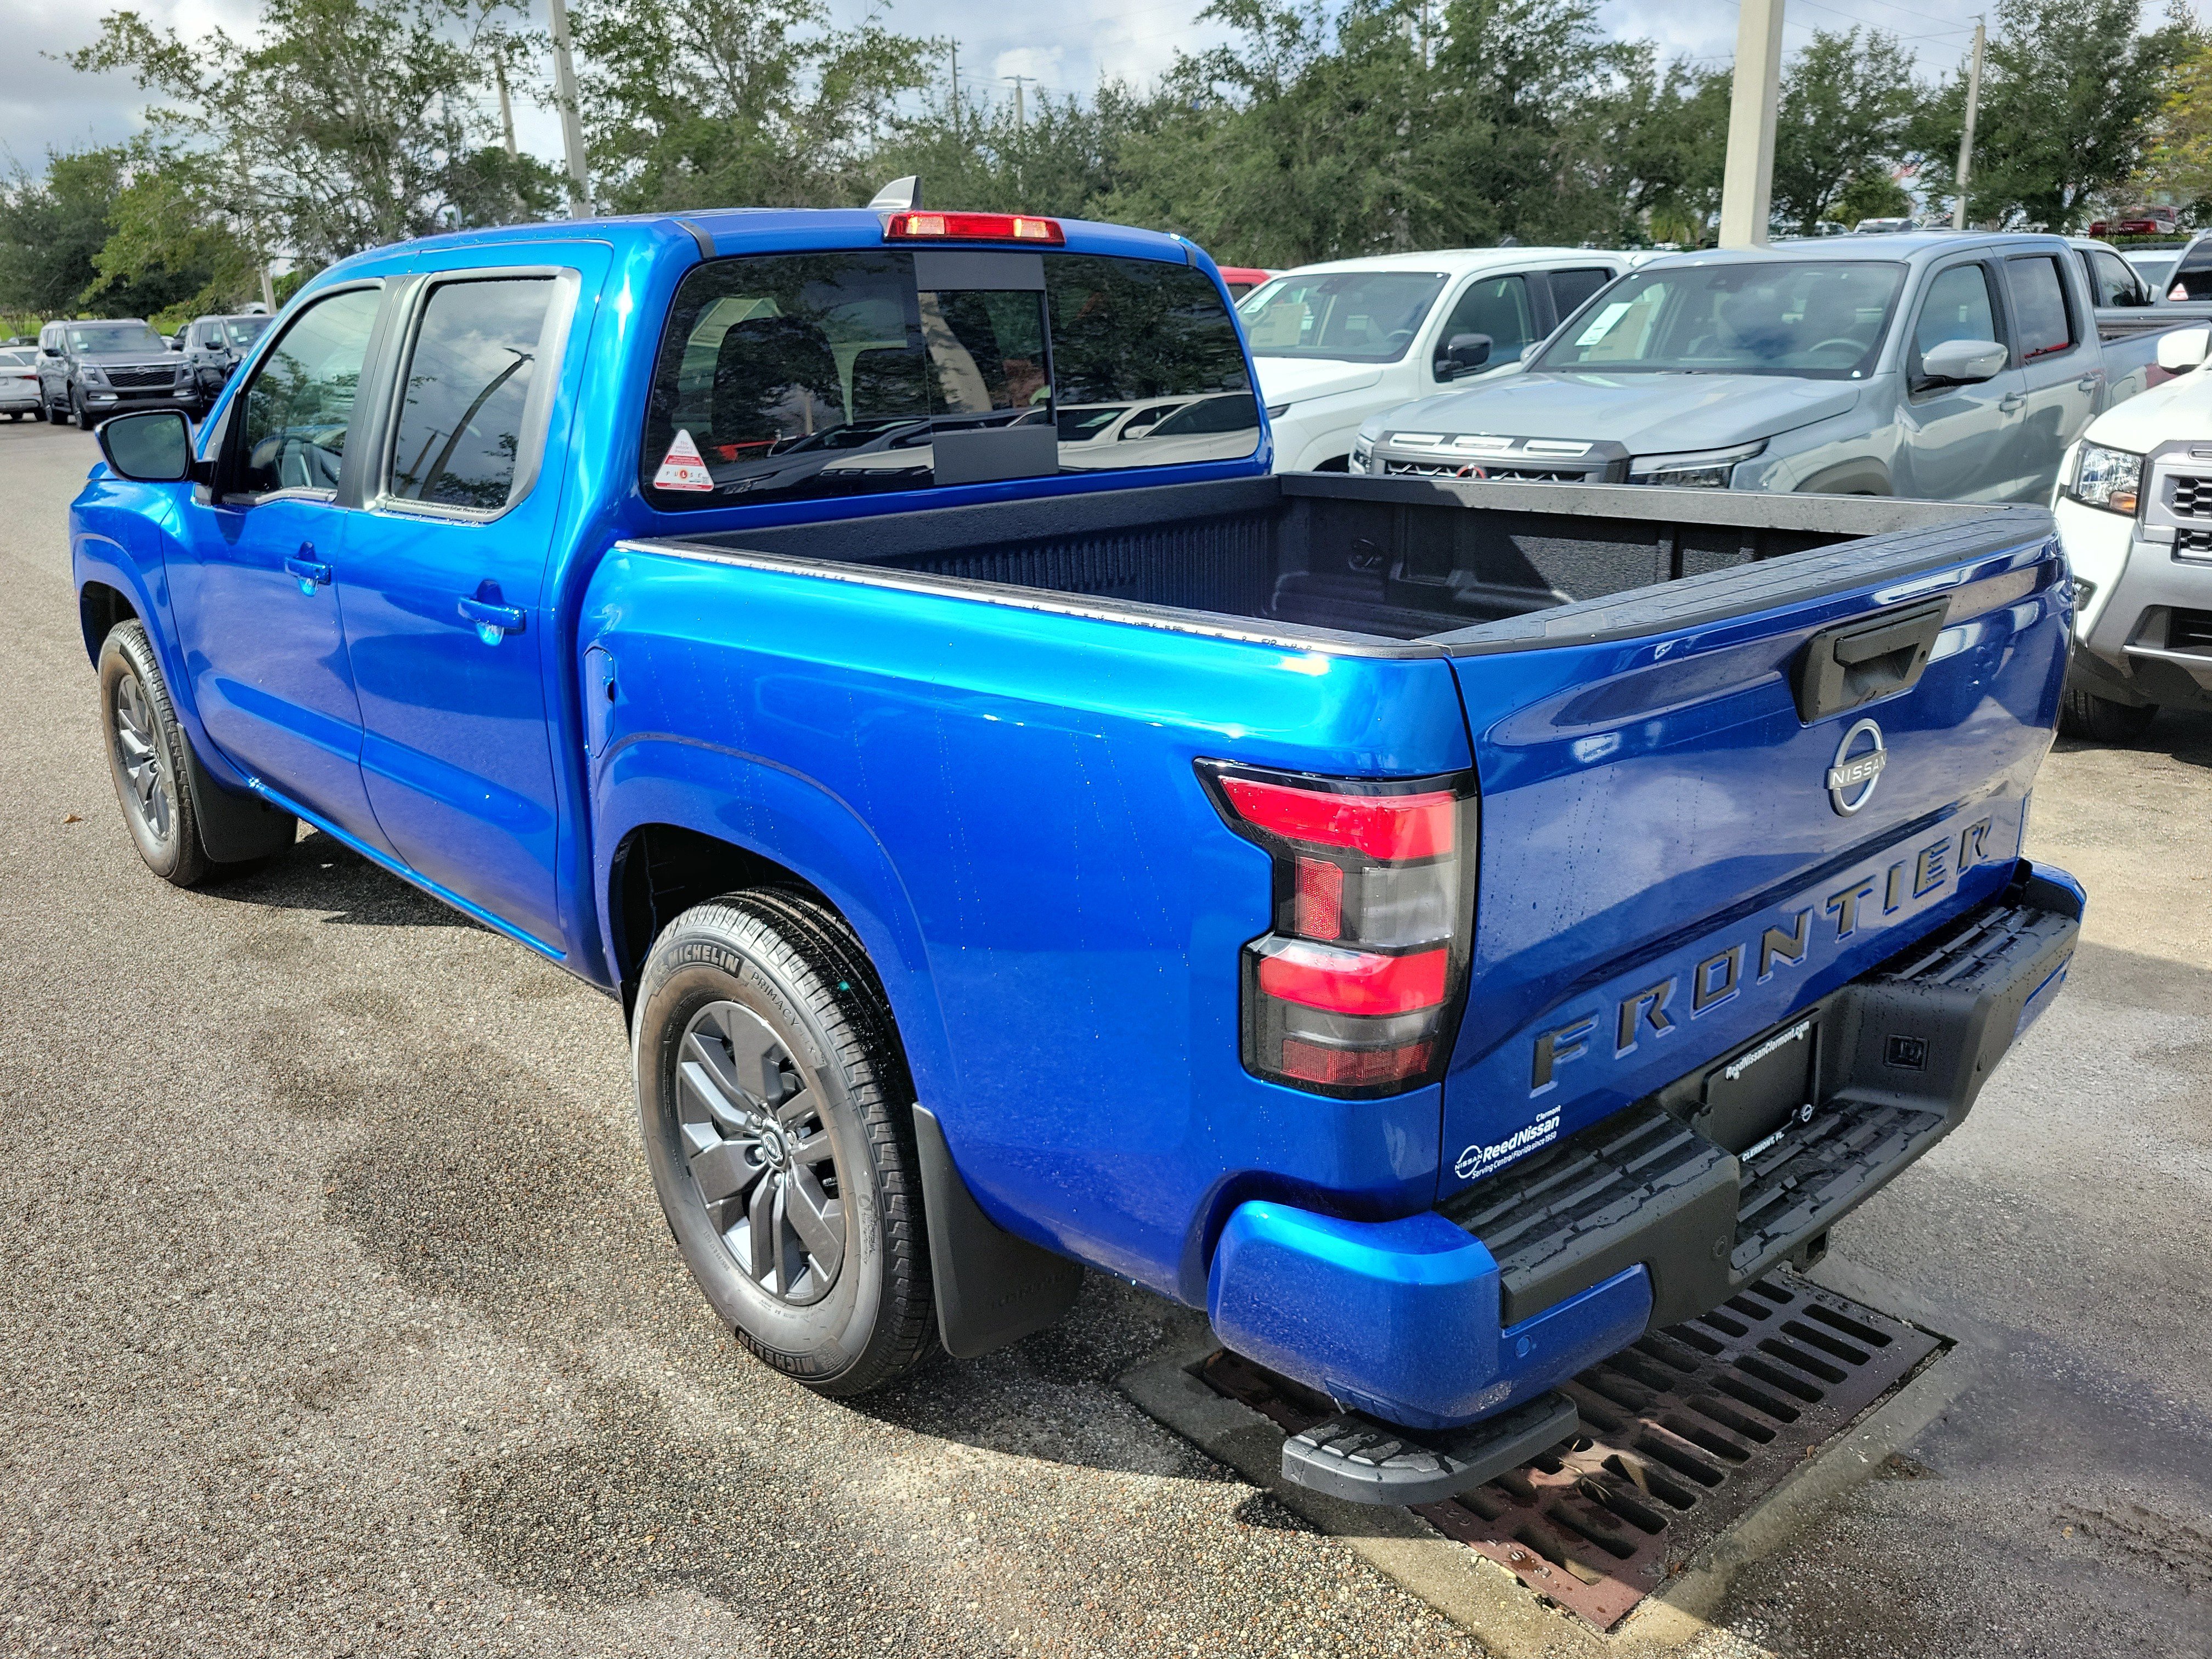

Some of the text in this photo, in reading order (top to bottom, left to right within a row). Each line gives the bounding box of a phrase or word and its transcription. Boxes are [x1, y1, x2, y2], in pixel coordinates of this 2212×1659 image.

[1832, 751, 1886, 786] NISSAN
[668, 944, 740, 973] MICHELIN
[1532, 816, 1993, 1096] FRONTIER
[751, 972, 800, 1027] PRIMACY
[1536, 1105, 1561, 1122] Clermont
[1455, 1153, 1483, 1171] NISSAN
[1472, 1164, 1493, 1179] Serving
[1493, 1152, 1513, 1169] Central
[1513, 1144, 1531, 1159] Florida
[738, 1330, 816, 1372] MICHELIN
